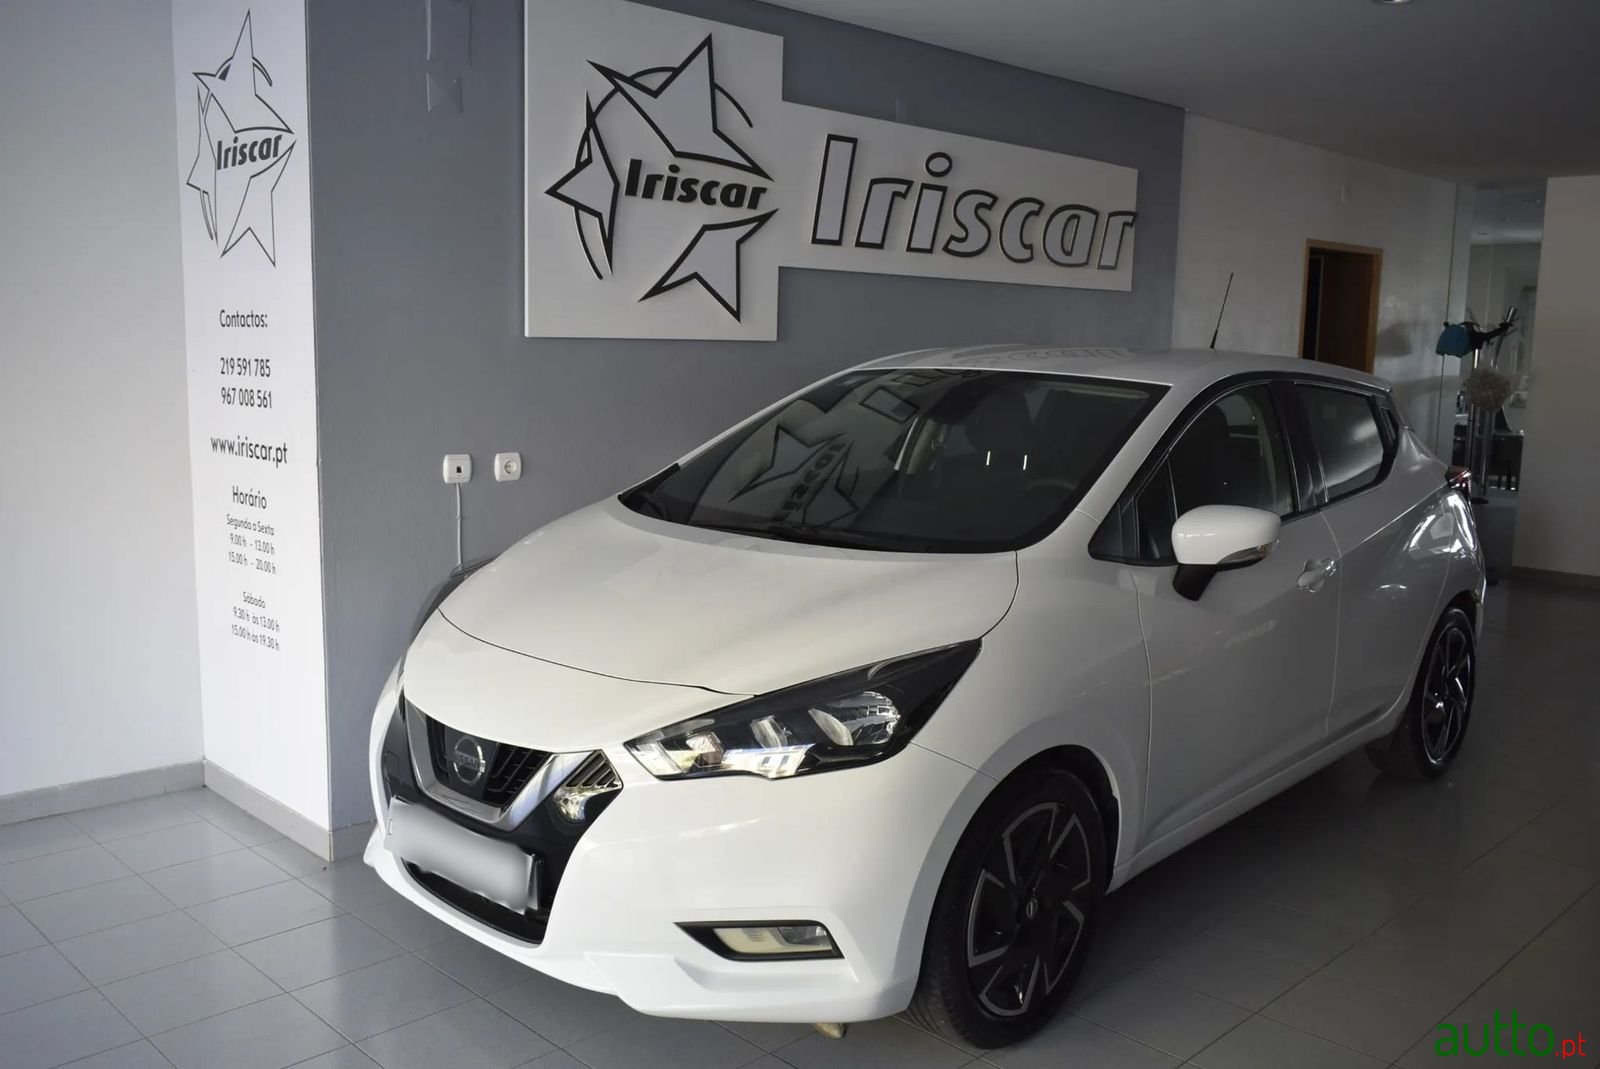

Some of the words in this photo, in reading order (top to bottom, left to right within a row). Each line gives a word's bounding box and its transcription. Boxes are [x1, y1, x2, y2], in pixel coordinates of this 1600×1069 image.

[216, 135, 283, 171] Iriscar
[624, 158, 768, 211] Iriscar
[810, 133, 1137, 272] Iriscar
[219, 309, 268, 328] Contactos:
[220, 357, 235, 376] 219
[237, 358, 252, 377] 591
[254, 359, 271, 378] 785
[221, 387, 236, 405] 967
[239, 388, 255, 407] 008
[257, 390, 273, 409] 561
[210, 435, 288, 468] www.iriscar.pt
[232, 485, 267, 509] Horário
[257, 520, 275, 536] Sexta
[230, 532, 242, 546] 9.00
[255, 540, 269, 554] 13.00
[228, 551, 243, 565] 15.00
[256, 558, 271, 573] 20.00
[243, 591, 266, 609] Sábado
[260, 616, 274, 631] 13.00
